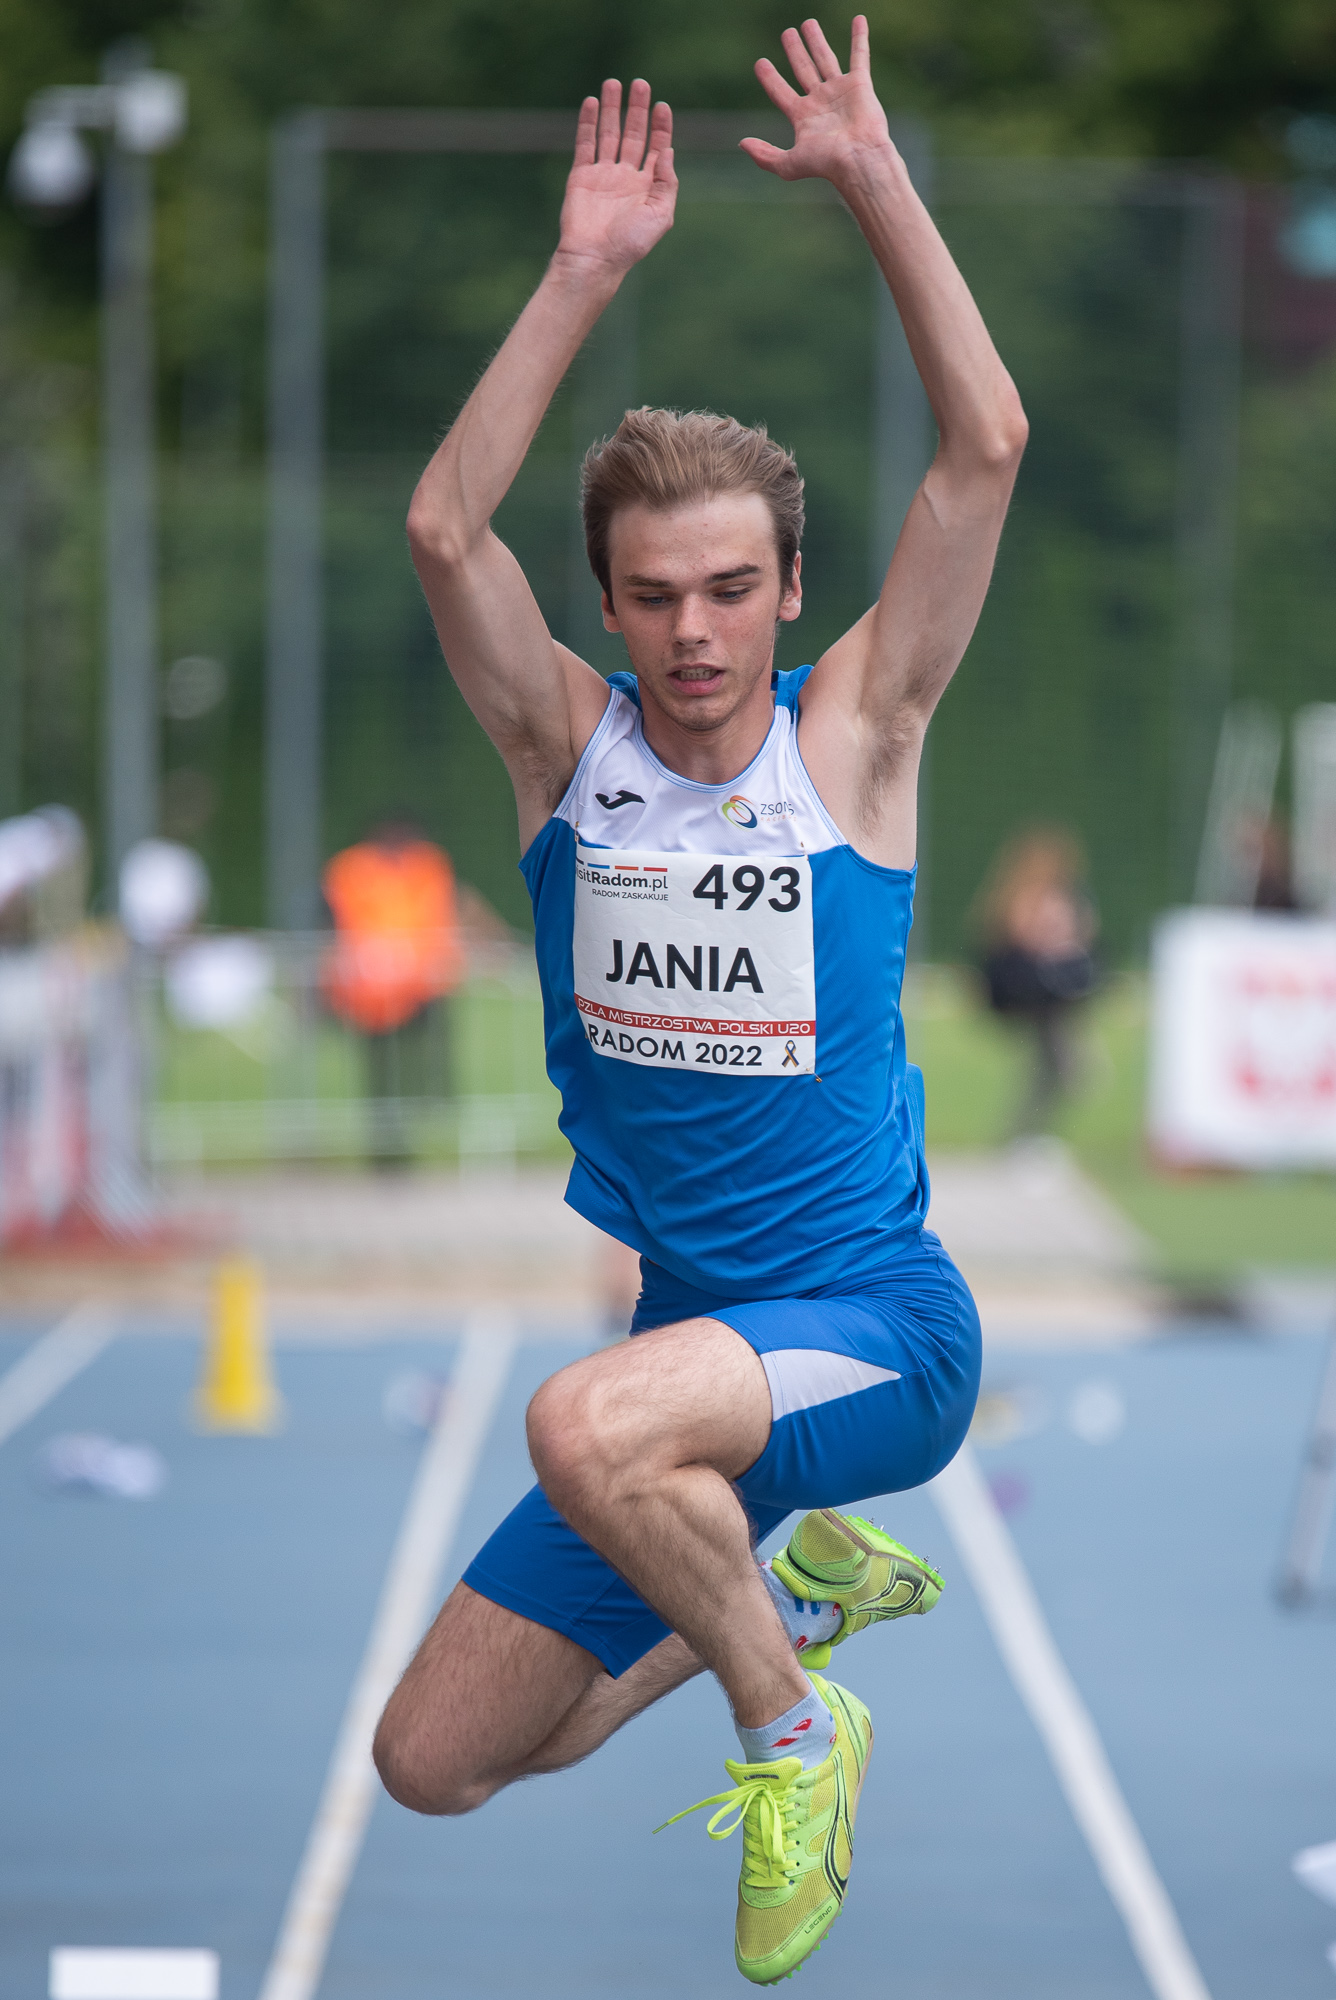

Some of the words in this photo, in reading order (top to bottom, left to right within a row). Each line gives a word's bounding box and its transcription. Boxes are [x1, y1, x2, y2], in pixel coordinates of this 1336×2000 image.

[577, 864, 669, 892] isitRadom.pl
[591, 888, 620, 899] RADOM
[621, 891, 669, 902] ZASKAKUJE
[692, 864, 801, 912] 493
[606, 939, 764, 993] JANIA
[578, 998, 606, 1018] PZLA
[608, 1009, 715, 1033] MISTRZOSTWA
[718, 1022, 773, 1035] POLSKI
[777, 1024, 811, 1035] U20
[587, 1022, 686, 1062] RADOM
[695, 1042, 762, 1067] 2022
[804, 1905, 833, 1935] LEGEND
